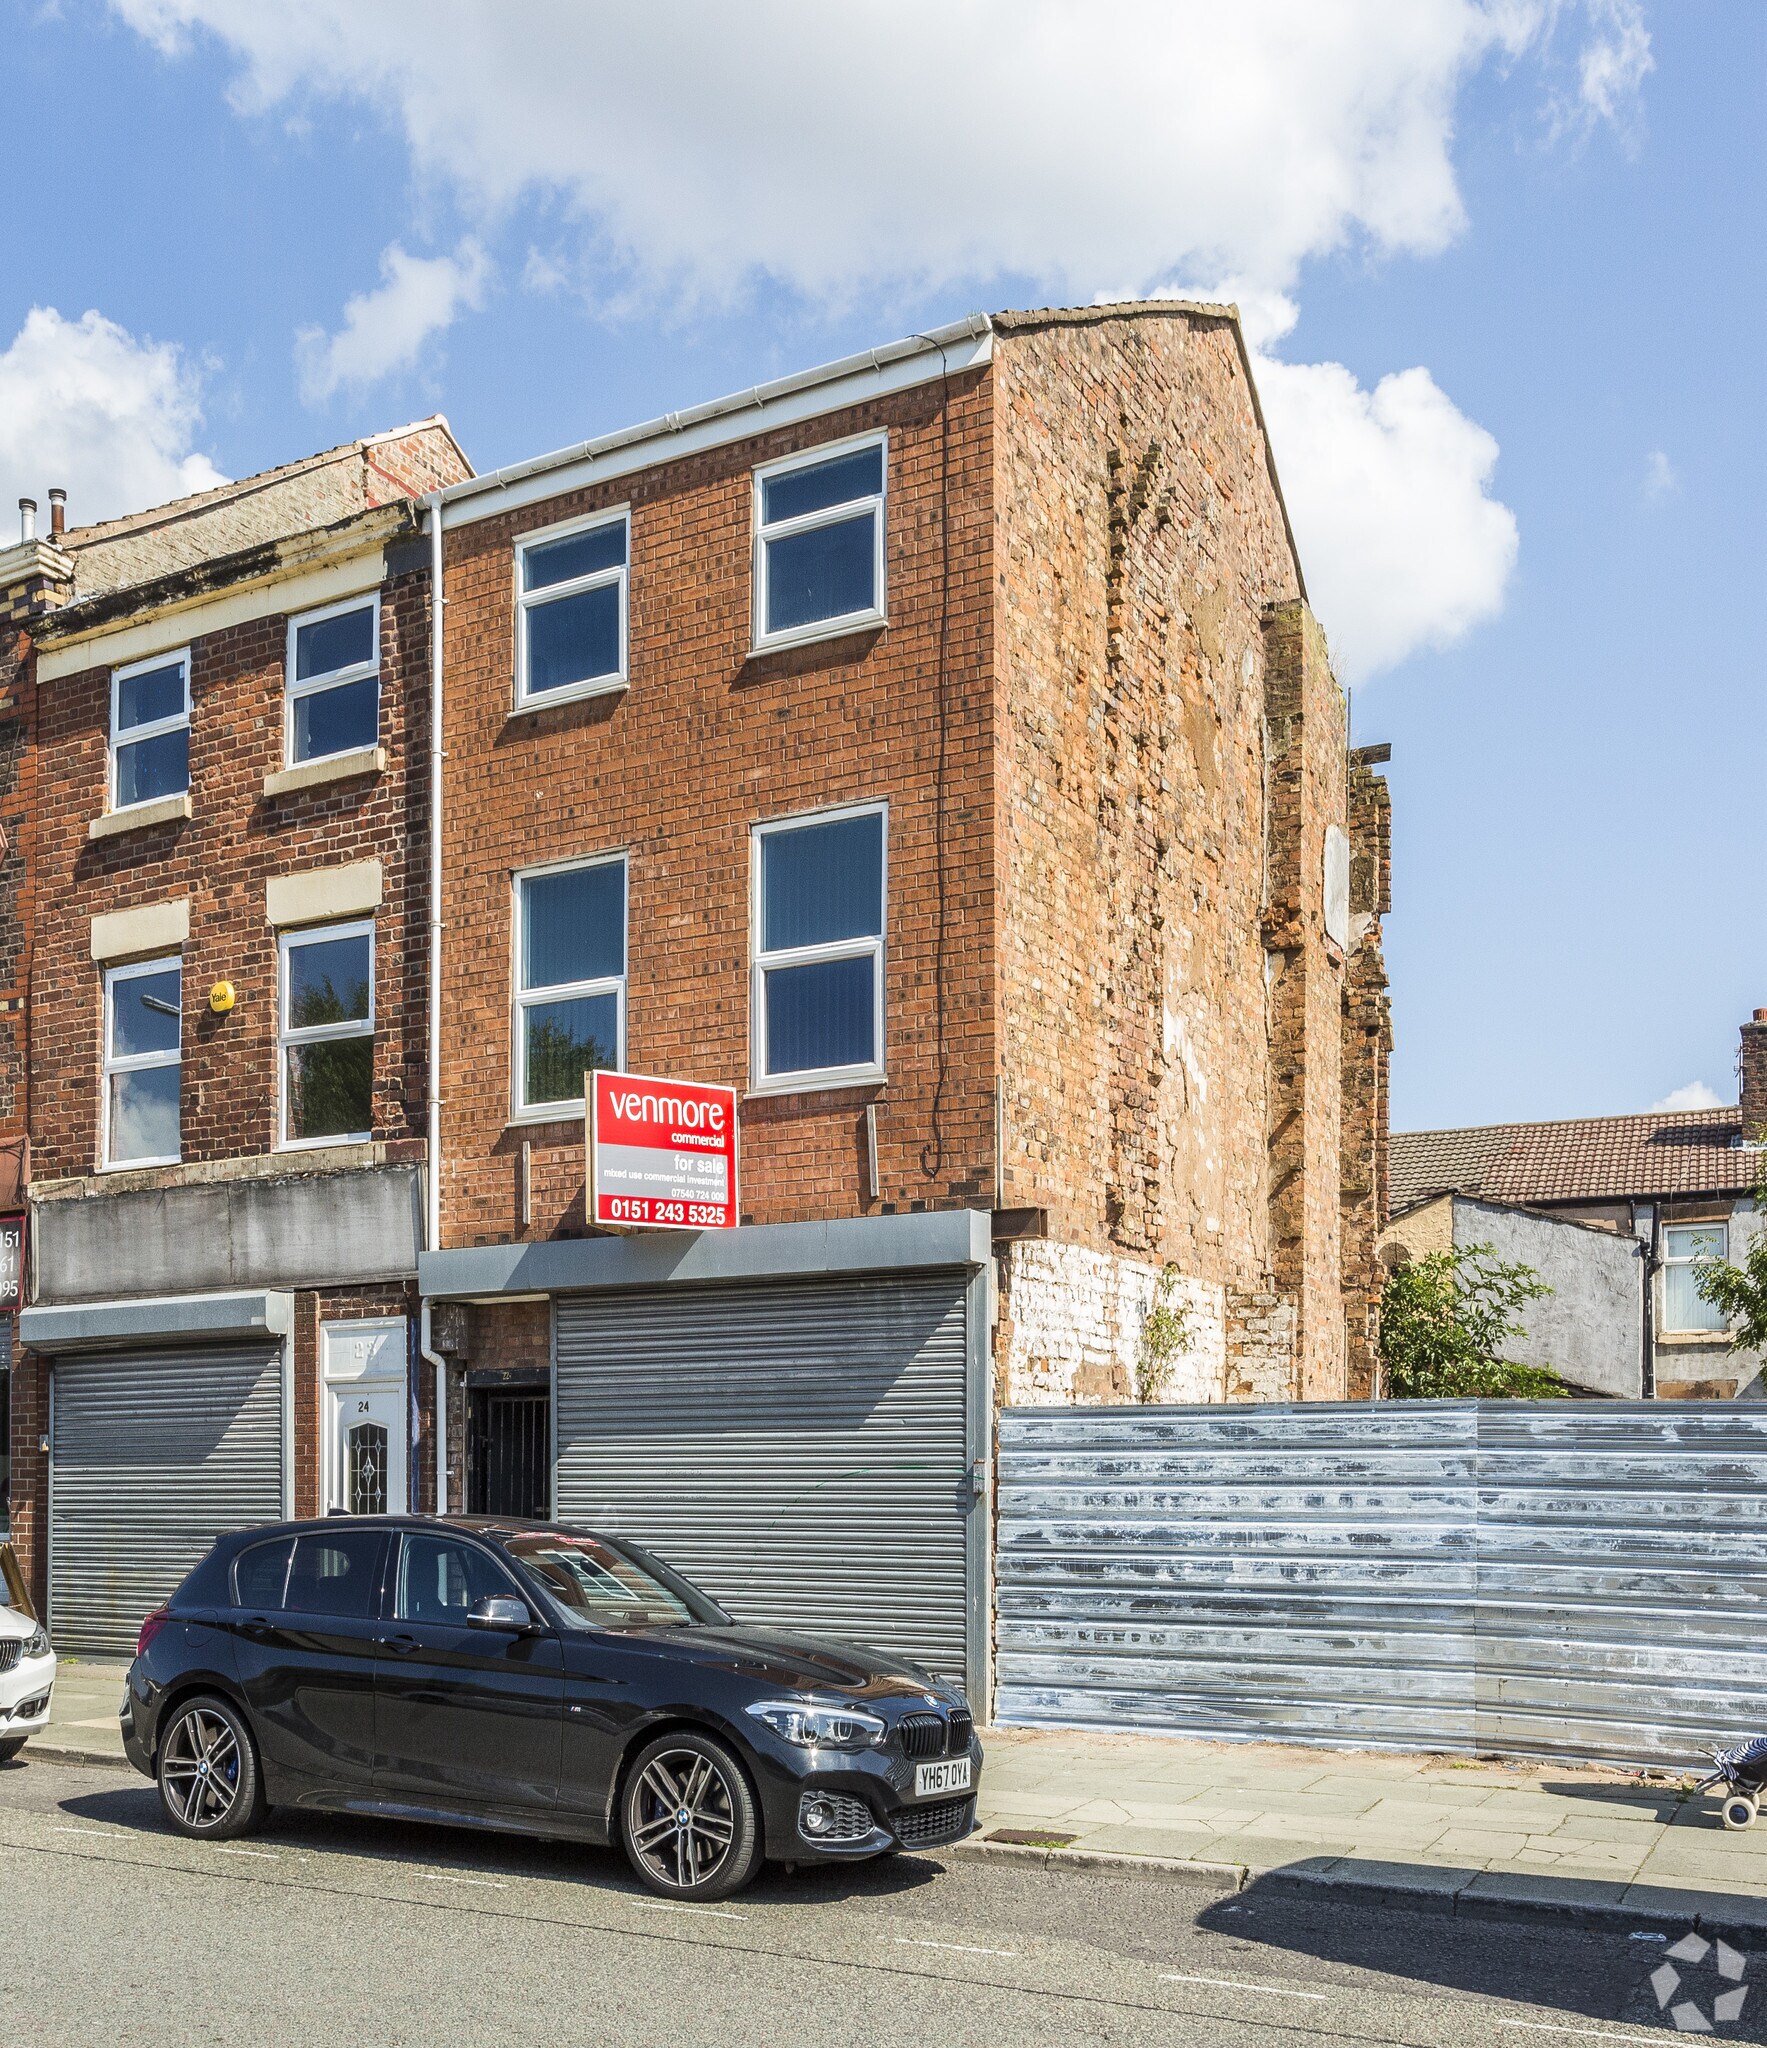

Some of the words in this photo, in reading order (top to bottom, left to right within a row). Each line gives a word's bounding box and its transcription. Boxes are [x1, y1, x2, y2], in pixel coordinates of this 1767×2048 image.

[211, 992, 226, 1003] Yale
[609, 1091, 725, 1131] venmore
[671, 1132, 725, 1148] commercial
[674, 1154, 694, 1171] for
[697, 1157, 724, 1174] sale
[603, 1168, 627, 1178] mixed
[628, 1172, 643, 1180] use
[643, 1171, 686, 1183] commercial
[686, 1174, 725, 1186] investment
[671, 1188, 694, 1198] 07540
[696, 1189, 709, 1199] 724
[611, 1198, 649, 1219] 0151
[655, 1202, 684, 1222] 243
[688, 1205, 726, 1225] 5325
[0, 1280, 18, 1297] 95
[358, 1401, 369, 1413] 24
[922, 1766, 950, 1790] YH67
[951, 1762, 968, 1785] OYA
